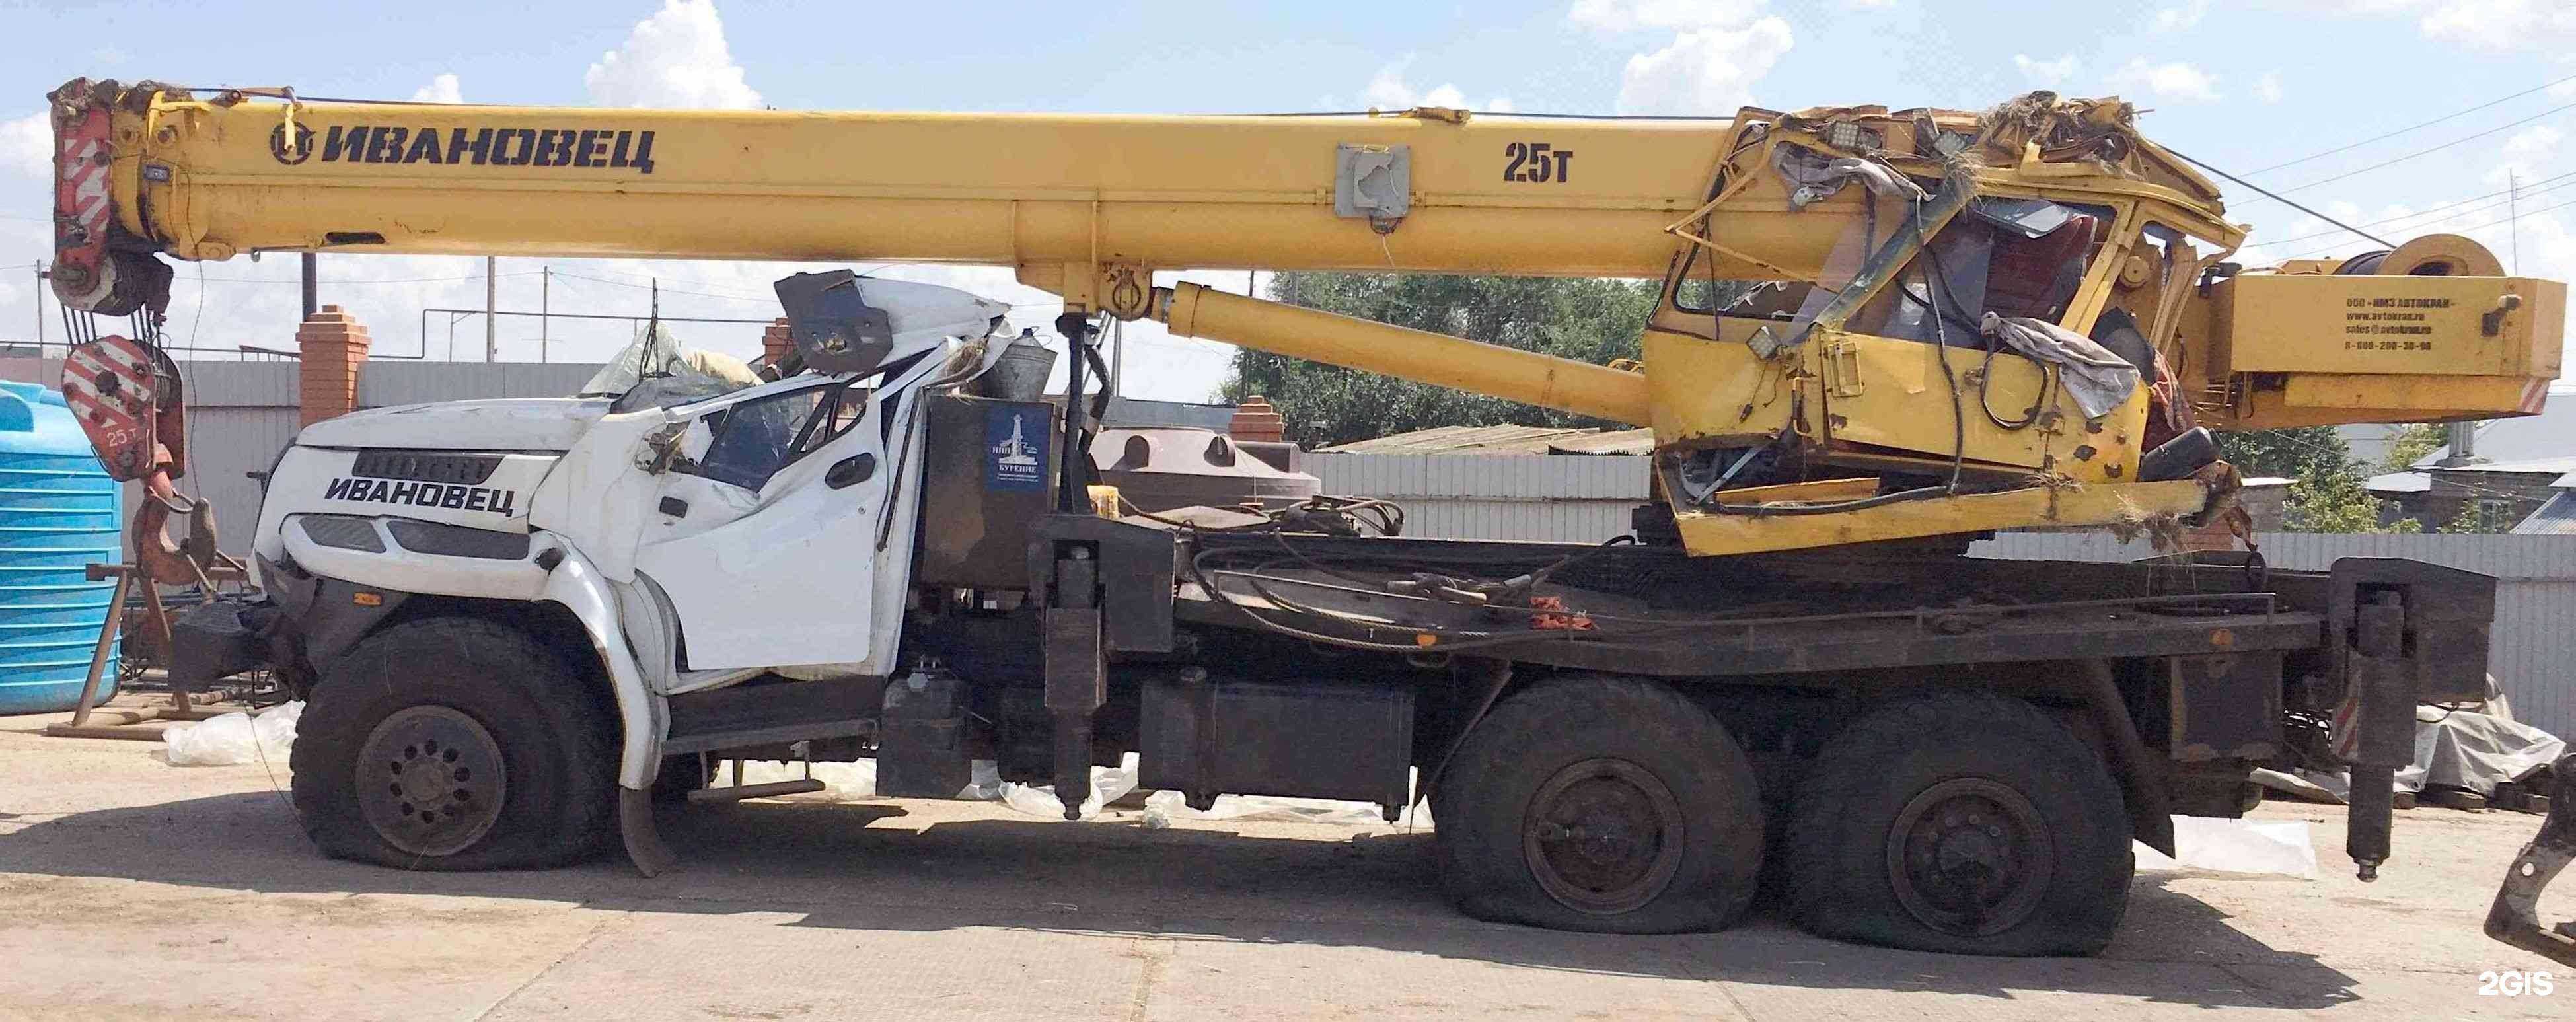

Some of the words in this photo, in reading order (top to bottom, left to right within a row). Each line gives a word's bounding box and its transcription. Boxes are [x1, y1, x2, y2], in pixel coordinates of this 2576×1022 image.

[322, 126, 655, 174] ИВАНОВЕЦ
[106, 430, 128, 447] 25
[324, 478, 515, 517] ИВАНОВЕЦ
